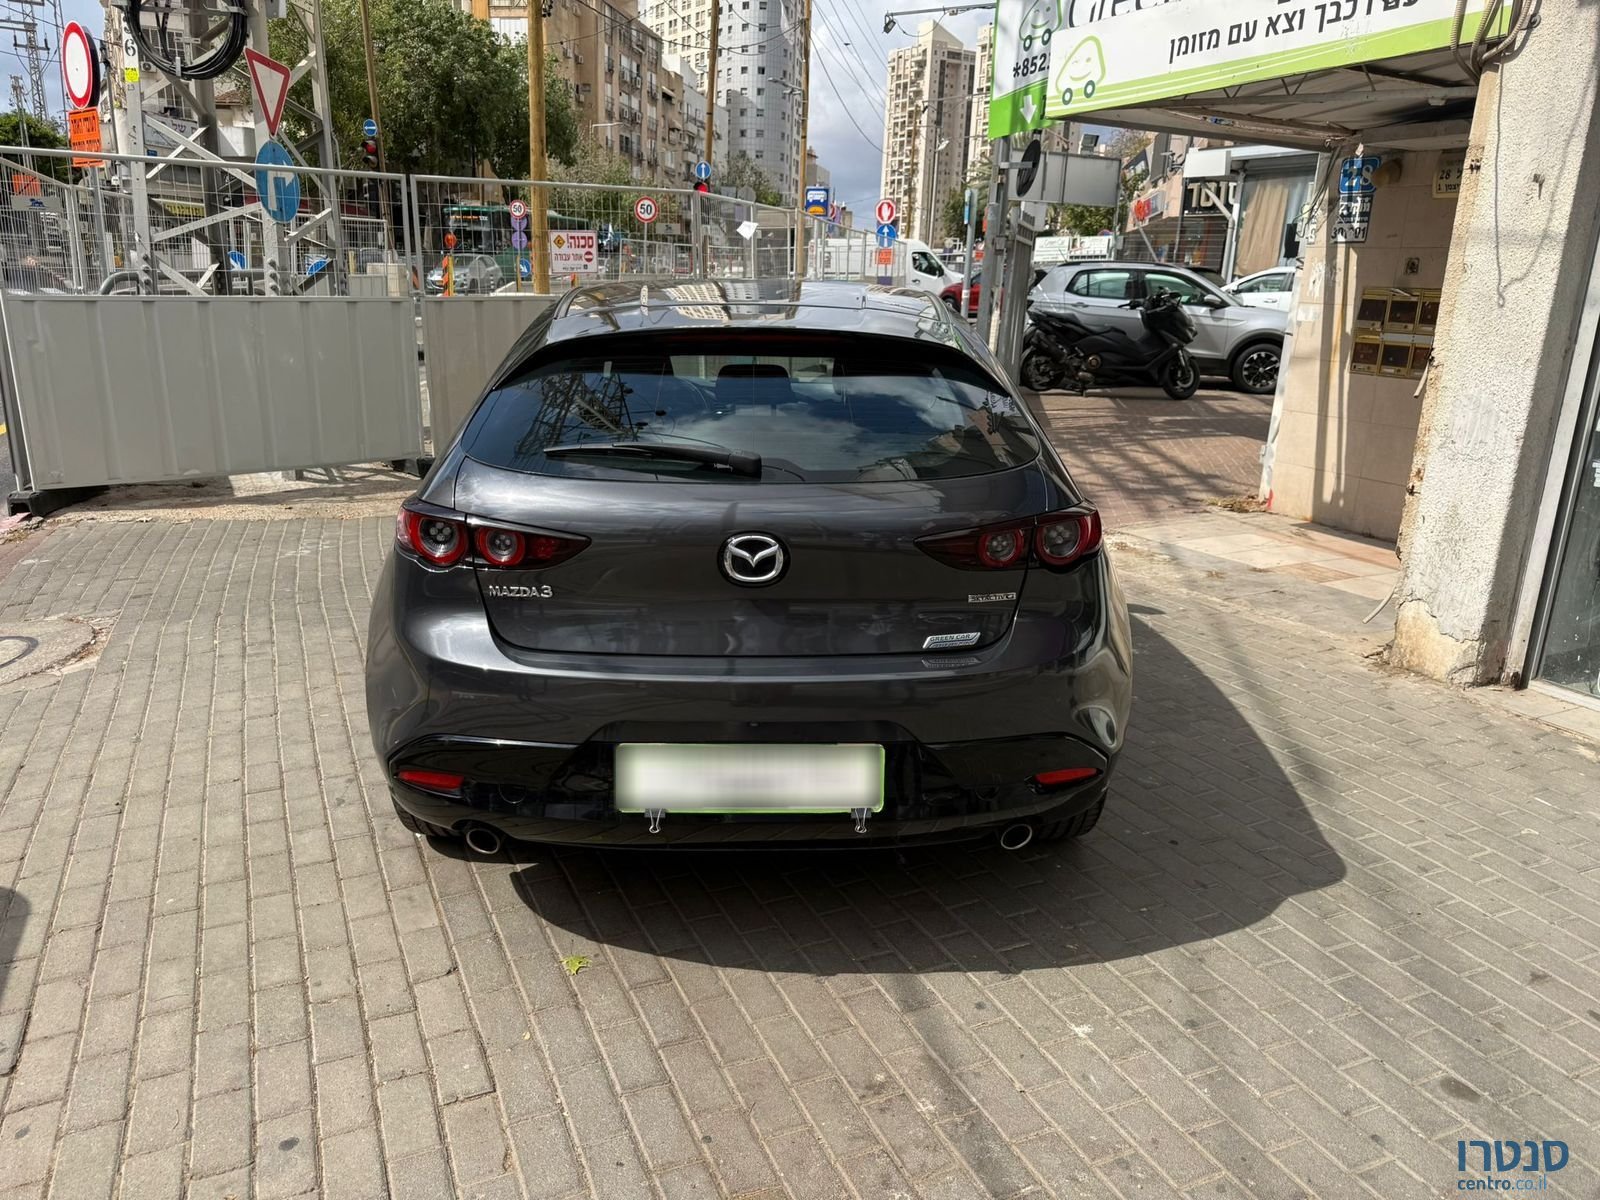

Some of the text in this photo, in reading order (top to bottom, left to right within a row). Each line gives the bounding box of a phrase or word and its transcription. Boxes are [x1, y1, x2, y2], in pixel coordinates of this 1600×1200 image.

[1228, 18, 1258, 46] עם
[1265, 7, 1305, 38] וצא
[1169, 28, 1221, 64] מזומן
[1345, 164, 1373, 187] 28
[513, 204, 523, 214] 50
[639, 204, 654, 217] 50
[567, 233, 594, 249] סכנה!
